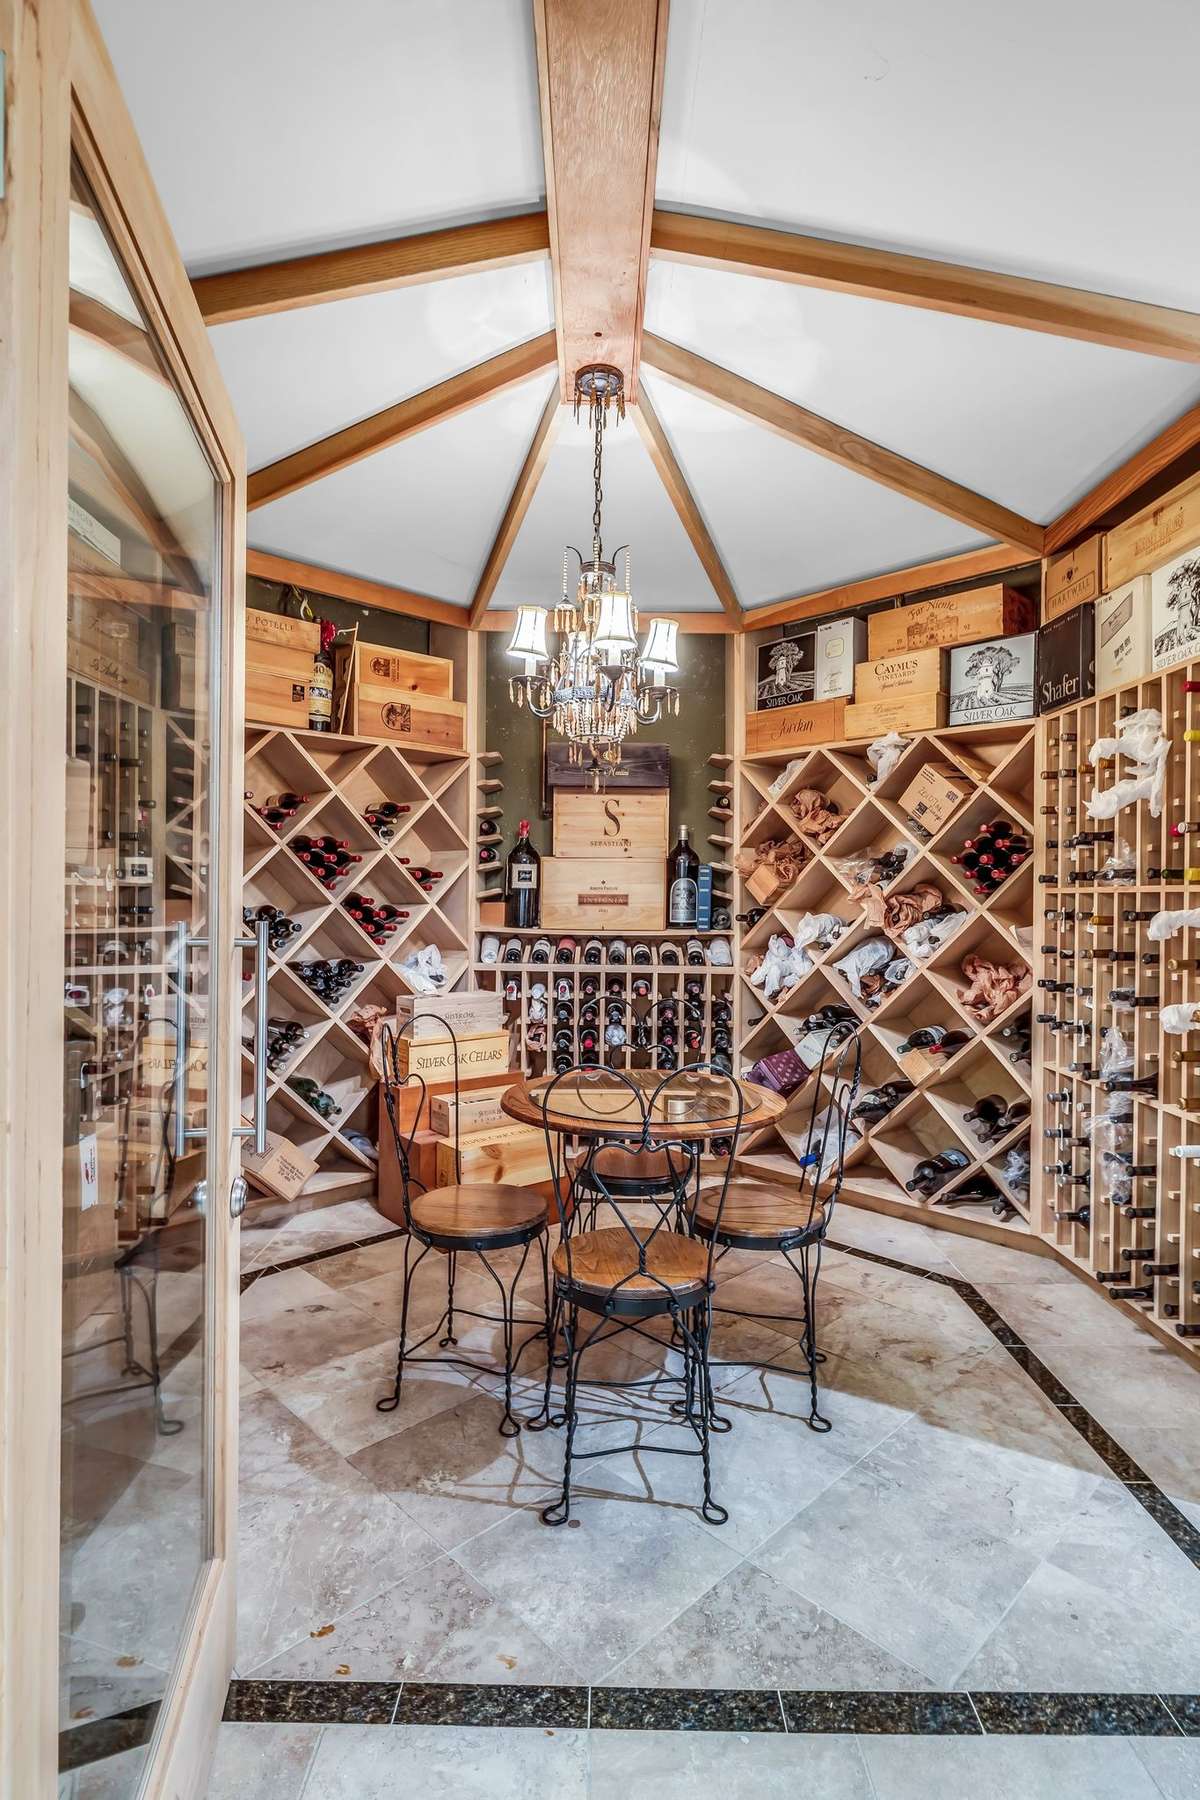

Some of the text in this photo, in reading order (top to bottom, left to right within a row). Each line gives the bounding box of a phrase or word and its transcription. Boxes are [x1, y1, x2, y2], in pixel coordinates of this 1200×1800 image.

[908, 607, 924, 619] Far
[874, 659, 918, 676] CAYMUS
[877, 670, 916, 681] VINEYARDS
[1042, 674, 1080, 705] Shafer
[765, 692, 803, 708] SILVER OAK
[962, 705, 1017, 722] SILVER OAK
[771, 718, 816, 740] Jordan
[604, 799, 620, 837] S
[416, 1056, 447, 1070] SILVER
[468, 1049, 503, 1063] CELLARS
